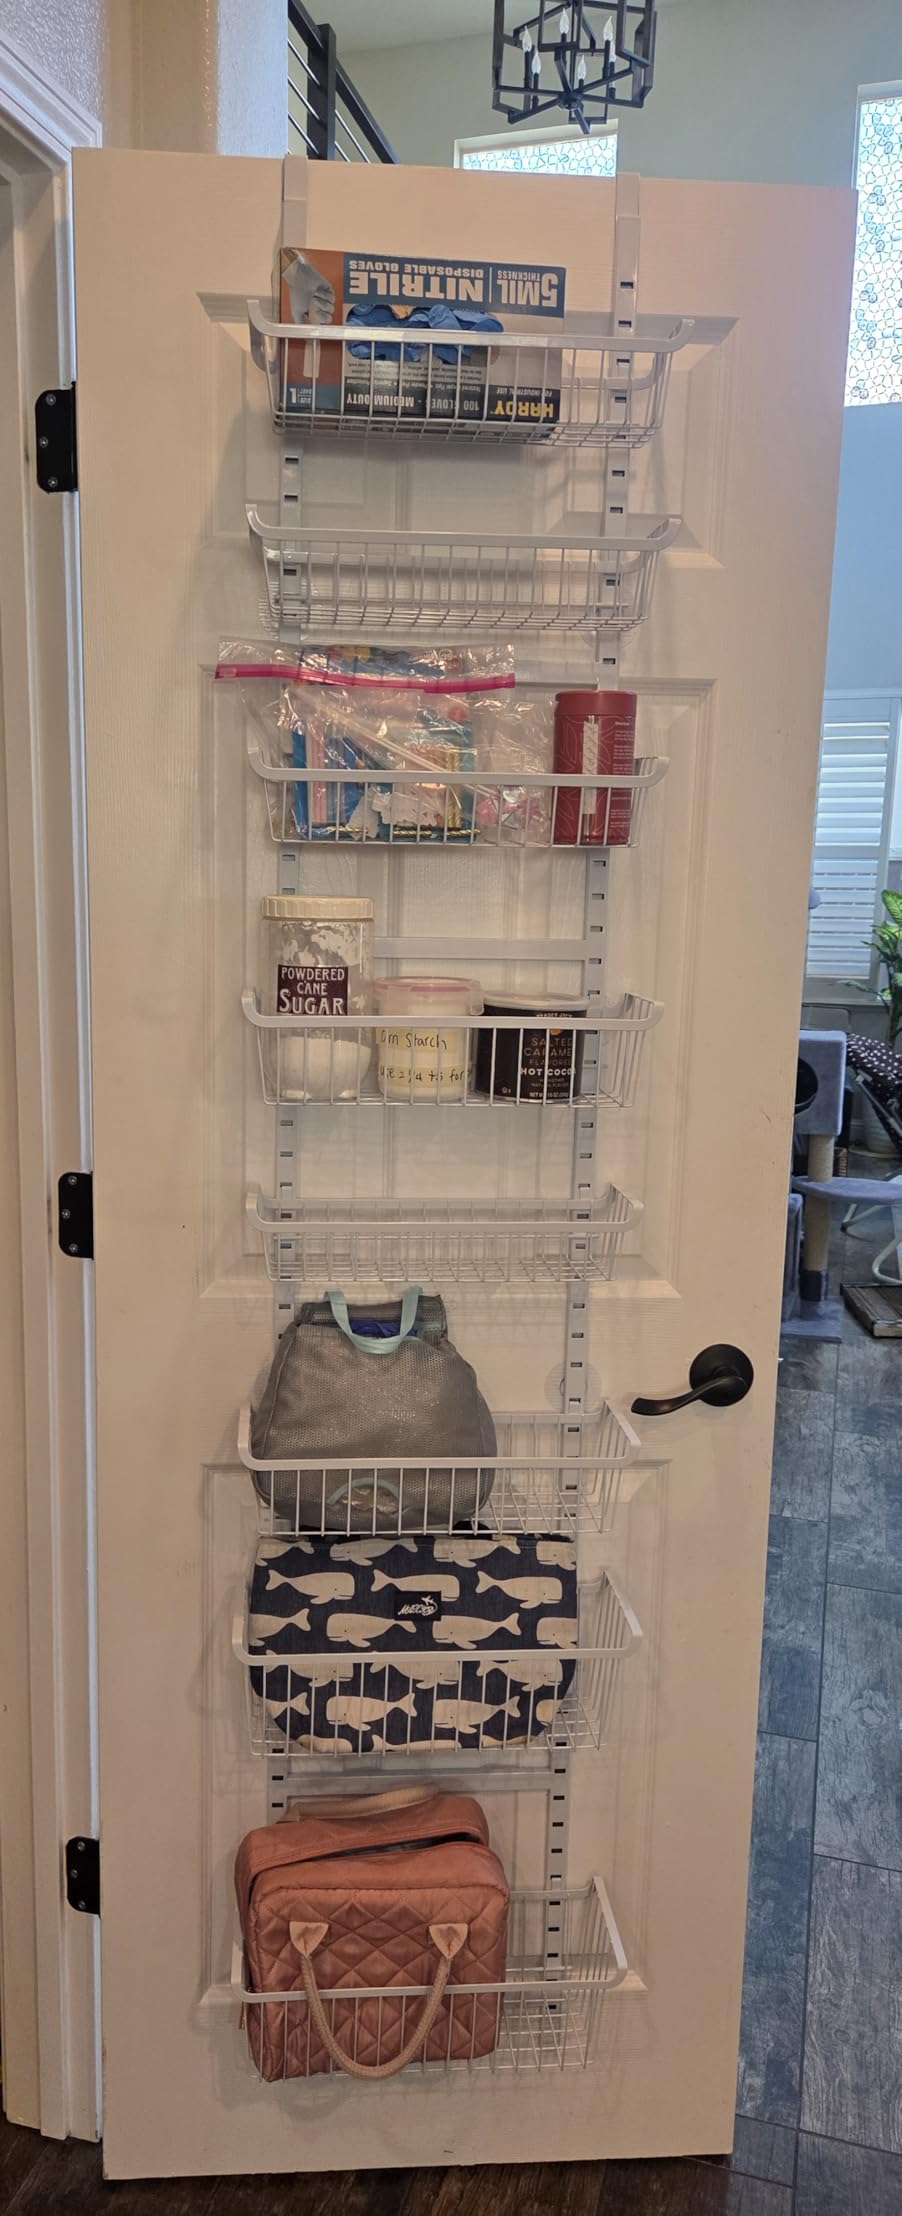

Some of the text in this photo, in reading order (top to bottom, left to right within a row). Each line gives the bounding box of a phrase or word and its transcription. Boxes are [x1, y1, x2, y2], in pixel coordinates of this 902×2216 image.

[349, 260, 484, 278] DISPOSABLE GLOVES
[497, 270, 541, 281] THICKNESS
[349, 271, 484, 302] NITRILE
[289, 387, 297, 404] L
[508, 387, 541, 397] INDUSTRAL
[542, 390, 552, 398] FO
[346, 393, 370, 405] DUTY
[374, 394, 414, 408] MEDIUM
[426, 398, 460, 411] LOVE
[463, 400, 480, 411] 100
[494, 400, 554, 418] HARDY
[281, 966, 345, 981] POWDERED
[296, 982, 328, 996] CANE
[279, 988, 344, 1016] SUGAR
[405, 1032, 447, 1050] Starch
[531, 1037, 574, 1047] SALTED
[524, 1047, 575, 1057] CARAME
[529, 1058, 573, 1066] FLAORE
[519, 1068, 543, 1077] HOT
